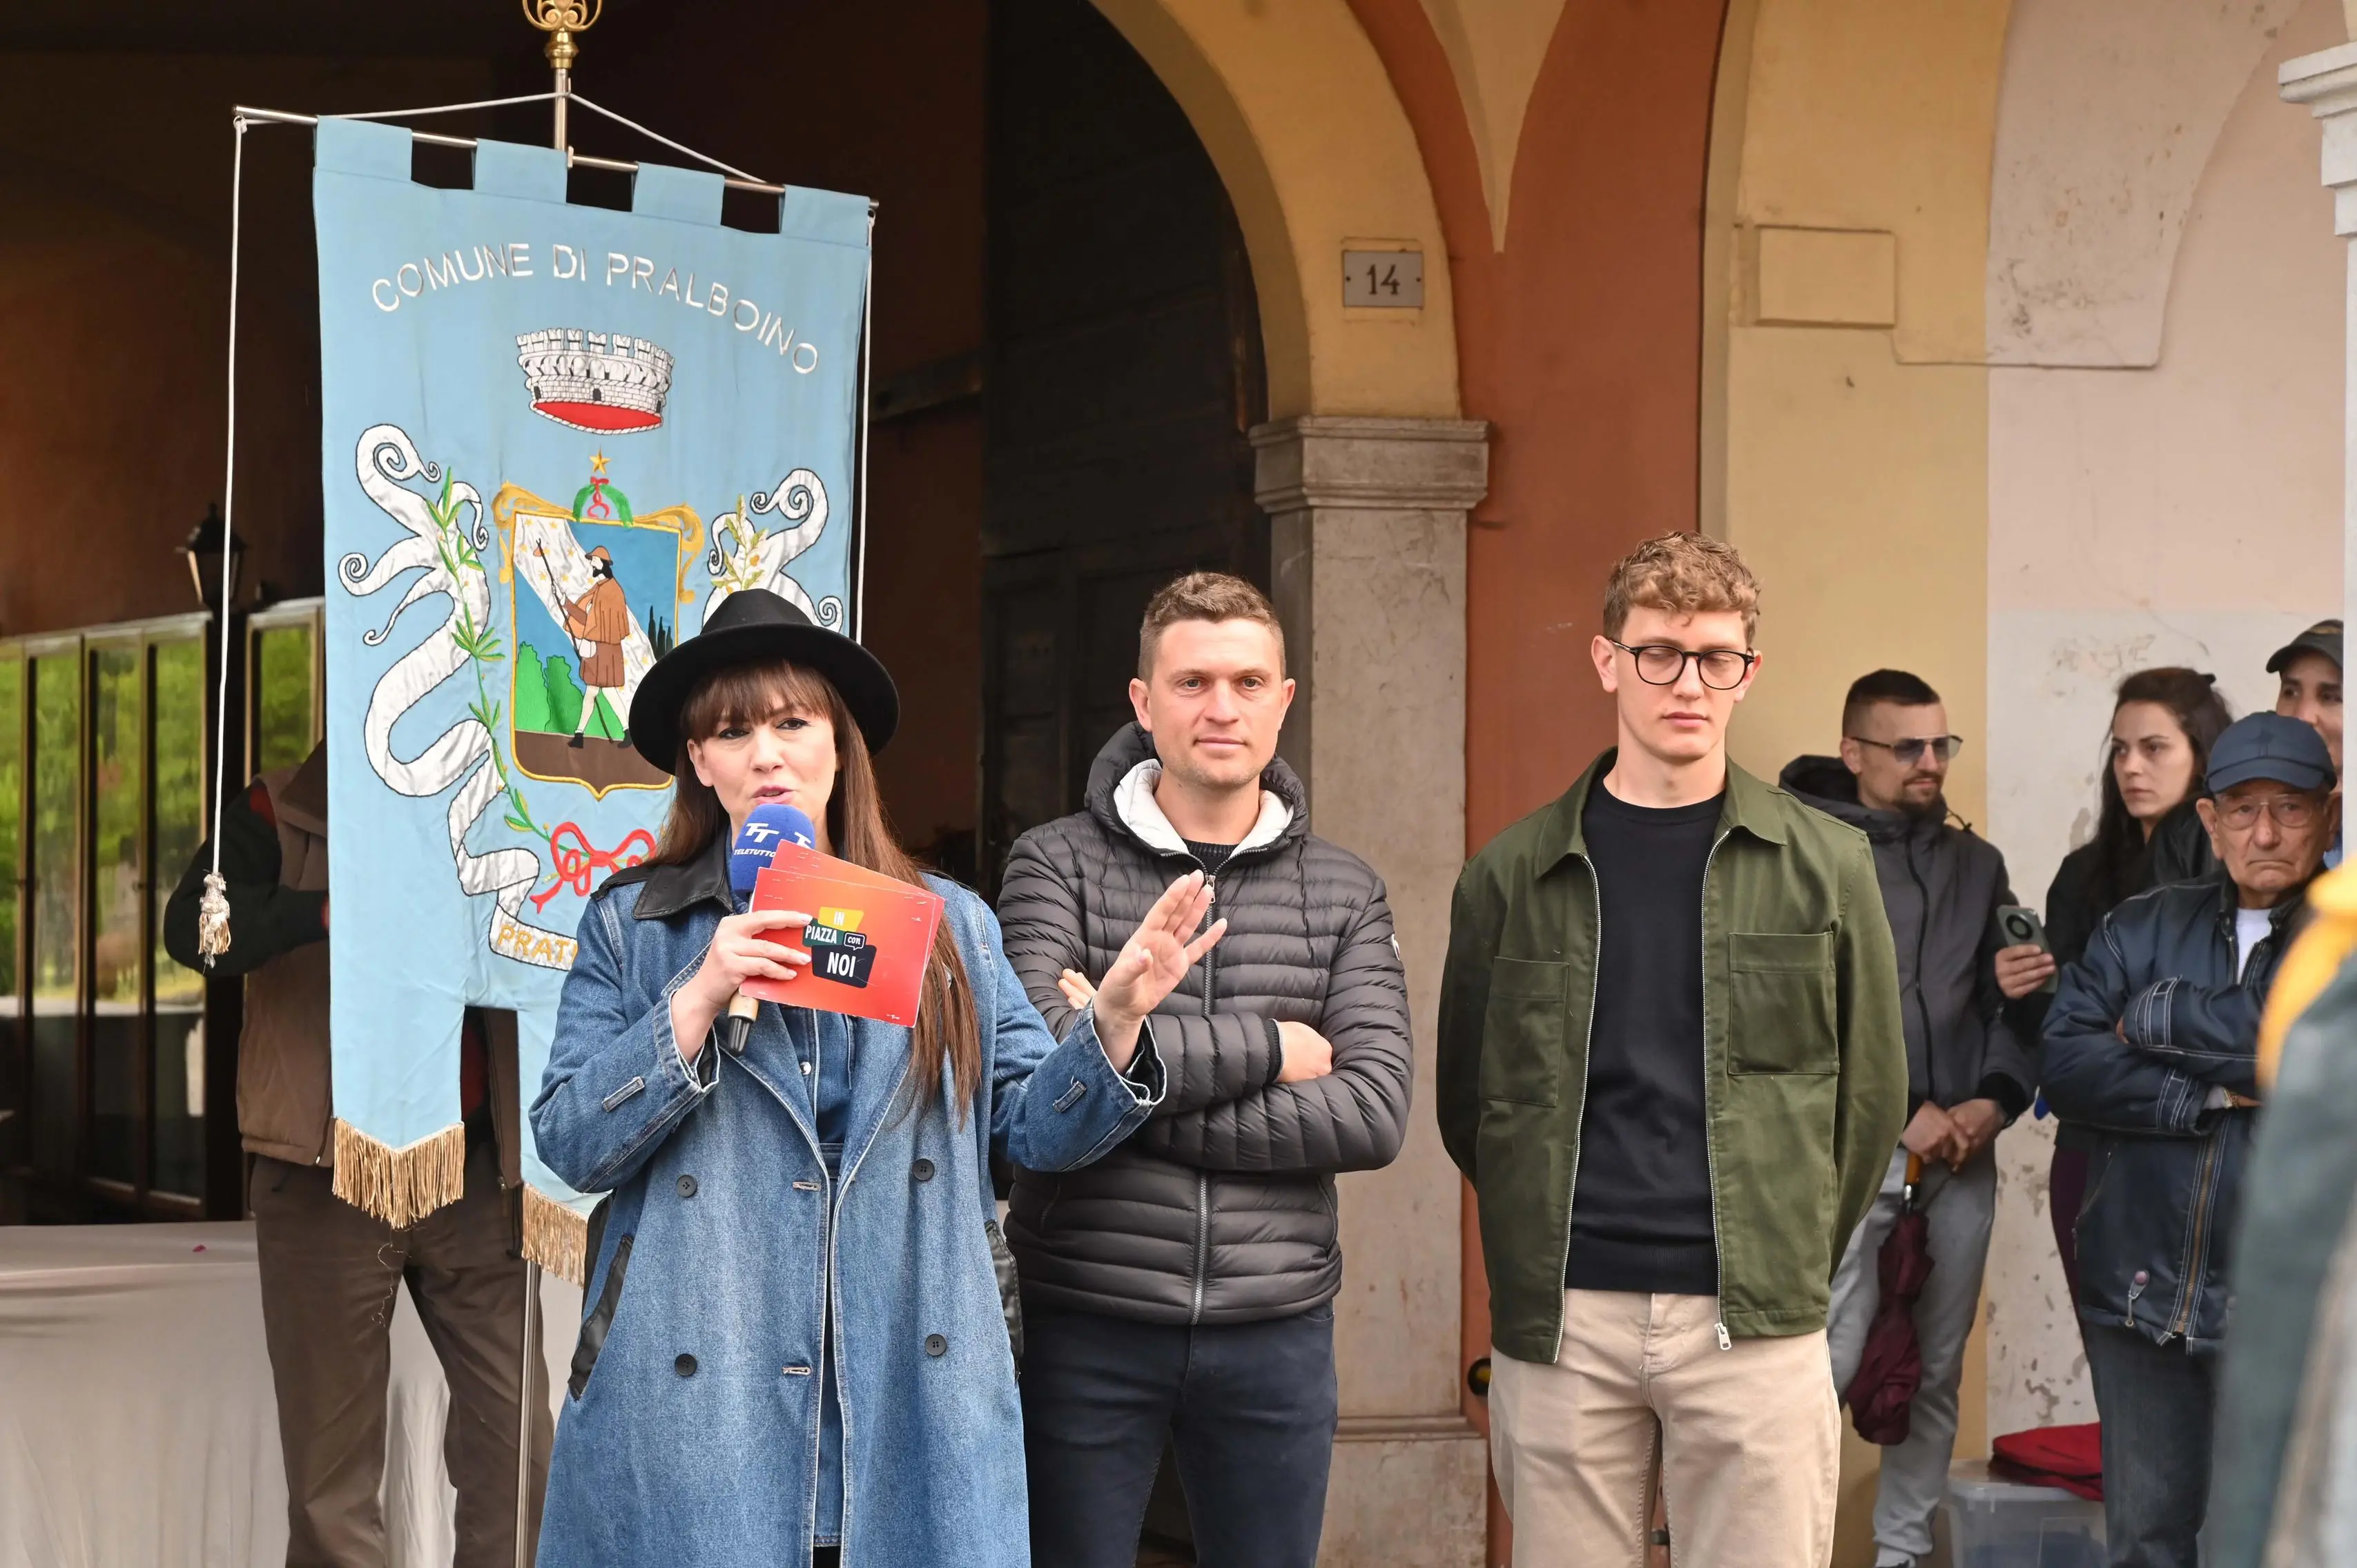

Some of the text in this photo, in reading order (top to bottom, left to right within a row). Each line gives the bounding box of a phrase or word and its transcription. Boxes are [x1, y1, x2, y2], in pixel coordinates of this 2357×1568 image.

[1366, 264, 1401, 296] 14
[372, 243, 819, 374] COMUNE DI PRALBOINO
[734, 848, 777, 858] TELETUTTO
[833, 911, 845, 926] IN
[805, 925, 861, 945] PIAZZA con
[826, 951, 856, 978] NOI
